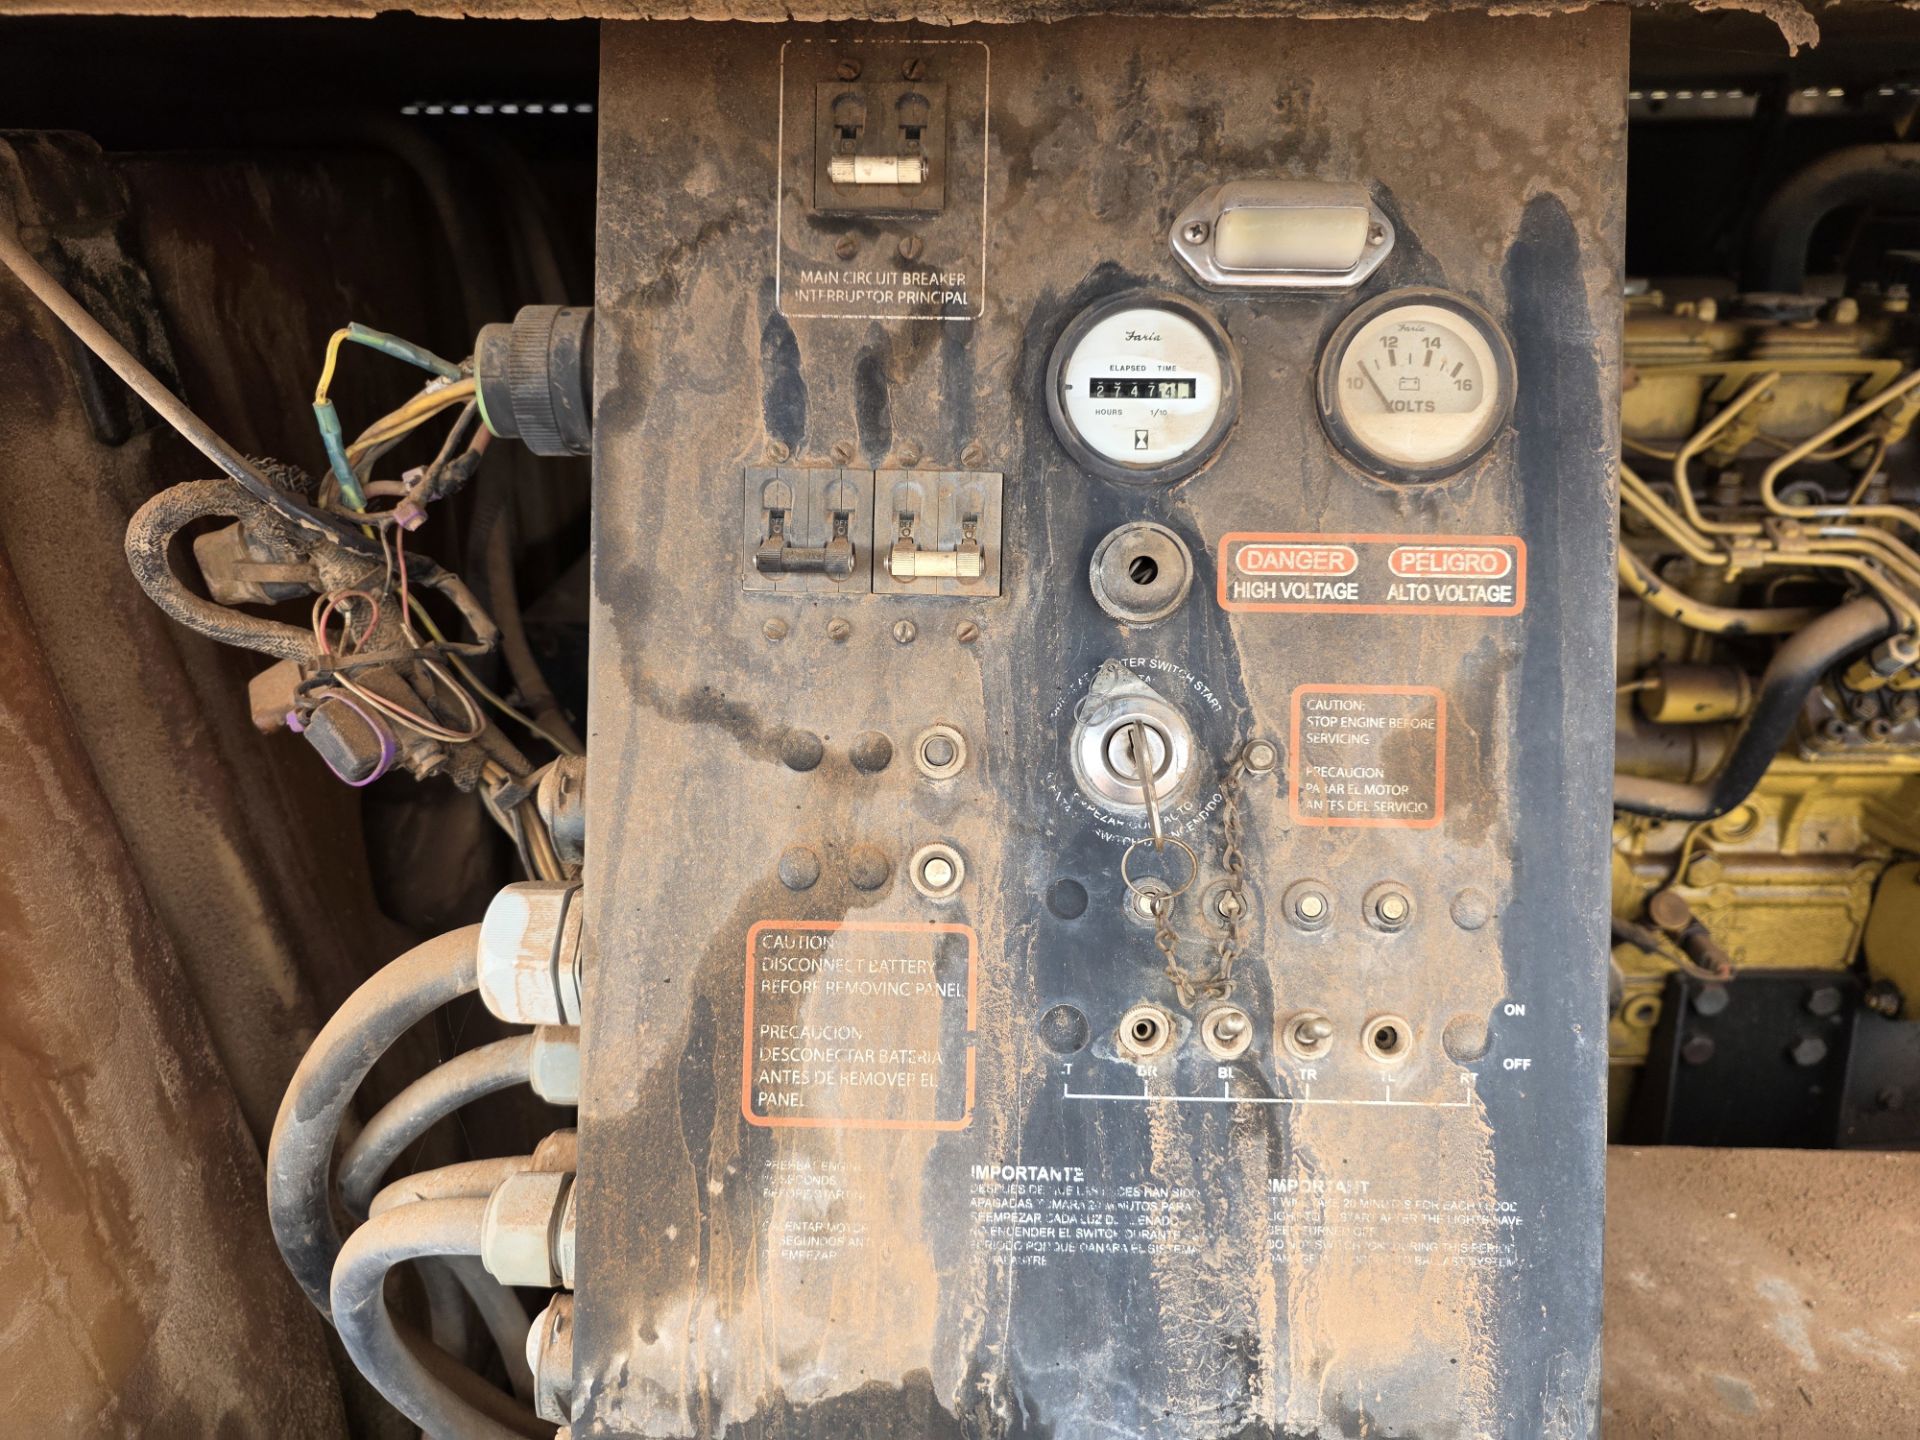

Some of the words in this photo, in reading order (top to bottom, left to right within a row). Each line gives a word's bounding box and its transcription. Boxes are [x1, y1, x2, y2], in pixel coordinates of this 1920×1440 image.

[801, 271, 839, 284] MAIN
[843, 272, 897, 286] CIRCUIT
[902, 272, 966, 286] BREAKER
[898, 291, 968, 305] PRINCIPAL
[1125, 331, 1162, 342] Faria
[1379, 336, 1399, 349] 12
[1422, 337, 1442, 350] 14
[1096, 382, 1190, 399] 27474
[1346, 377, 1364, 391] 10
[1454, 379, 1473, 392] 16
[1150, 409, 1168, 418] 1/10
[1247, 550, 1345, 570] DANGER
[1401, 552, 1498, 573] PELIGRO
[1233, 582, 1276, 599] HIGH
[1281, 583, 1359, 600] VOLTAGE
[1387, 583, 1430, 602] ALTO
[1432, 584, 1511, 603] VOLTAGE
[1149, 659, 1195, 684] SWITCH
[1306, 715, 1338, 728] STOP
[1341, 717, 1386, 728] ENGINE
[1389, 718, 1435, 729] BEFORE
[1306, 733, 1370, 745] SERVICING
[1348, 784, 1362, 796] EL
[1364, 784, 1409, 796] MOTOR
[1348, 801, 1370, 812] DEL
[1373, 801, 1428, 813] SERVICIO
[1504, 1004, 1526, 1017] ON
[1503, 1058, 1532, 1071] OFF
[758, 1070, 809, 1085] ANTES
[1299, 1069, 1318, 1081] TR
[970, 1165, 1085, 1182] IMPORTANTE
